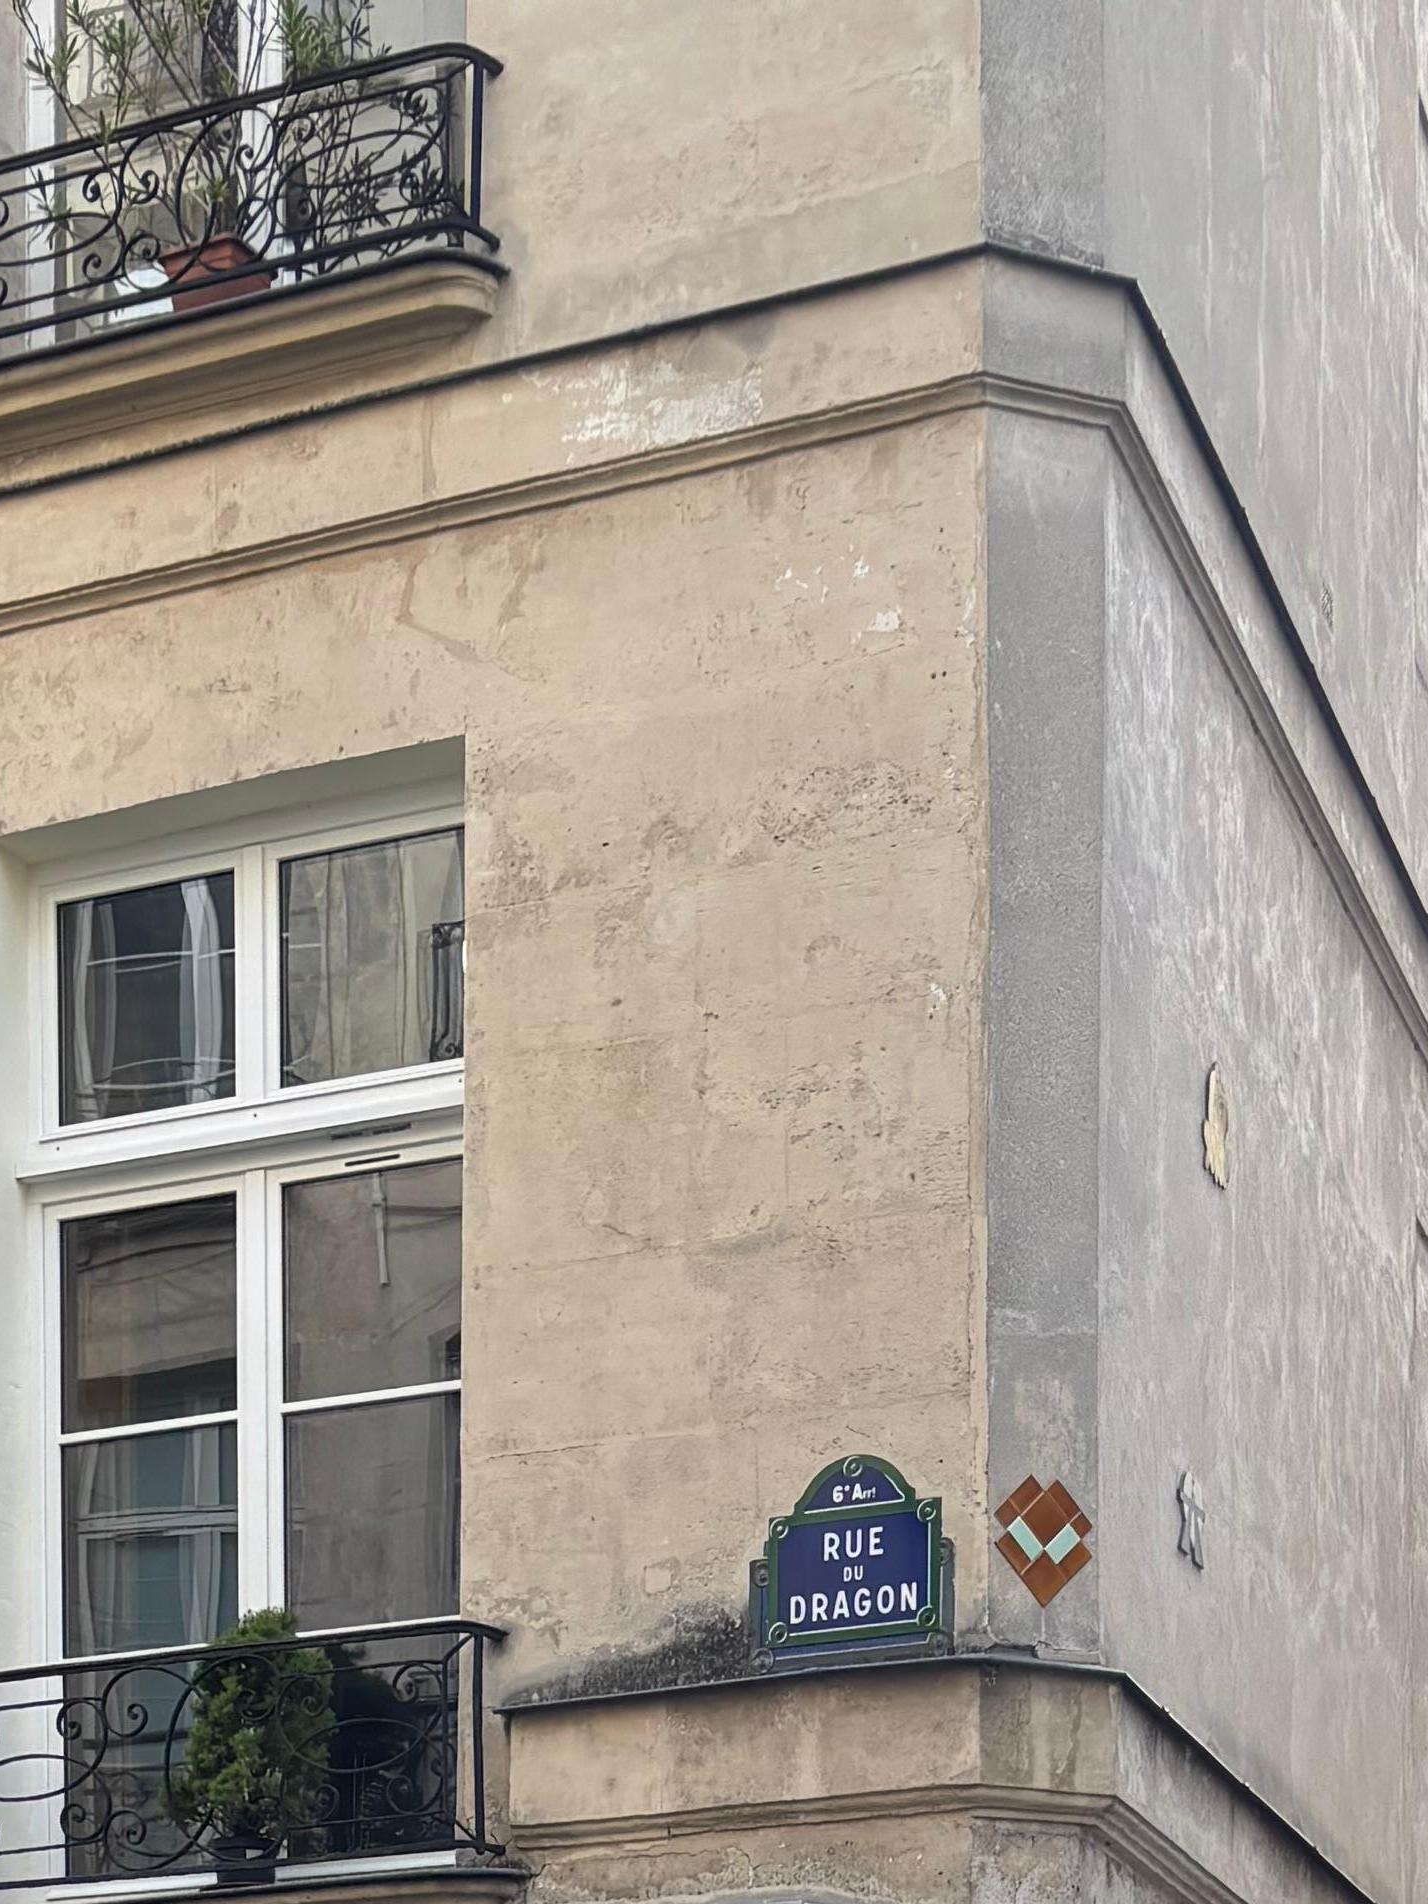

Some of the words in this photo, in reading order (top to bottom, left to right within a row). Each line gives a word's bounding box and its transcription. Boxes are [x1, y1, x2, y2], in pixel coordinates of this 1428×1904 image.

[823, 1526, 884, 1561] RUE
[843, 1565, 863, 1582] DU
[789, 1582, 918, 1625] DRAGON
